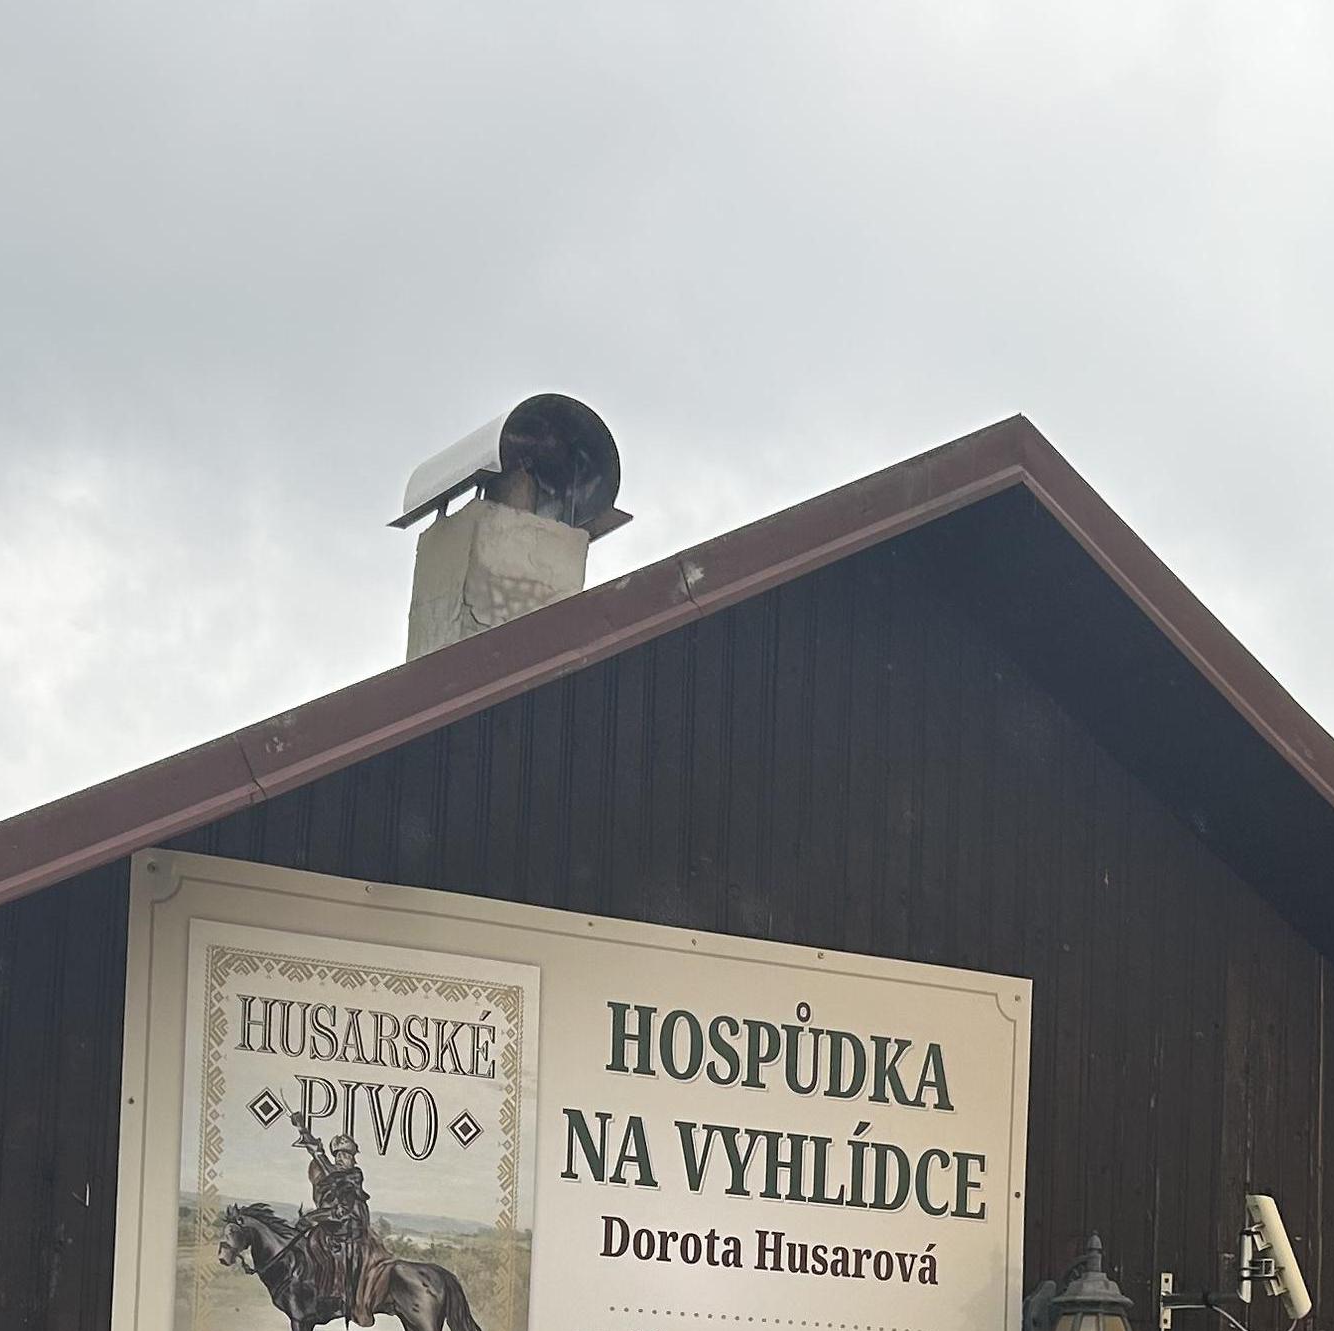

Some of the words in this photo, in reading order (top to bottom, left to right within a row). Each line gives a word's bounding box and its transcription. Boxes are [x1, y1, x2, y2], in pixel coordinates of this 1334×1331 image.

[234, 993, 496, 1079] HUSARSKÉ
[605, 1001, 955, 1112] HOSPŮDKA
[291, 1074, 439, 1161] PIVO
[560, 1107, 660, 1189] NA
[674, 1120, 987, 1220] VYHLÍDCE
[599, 1215, 743, 1268] Dorota
[754, 1230, 939, 1286] Husarová
